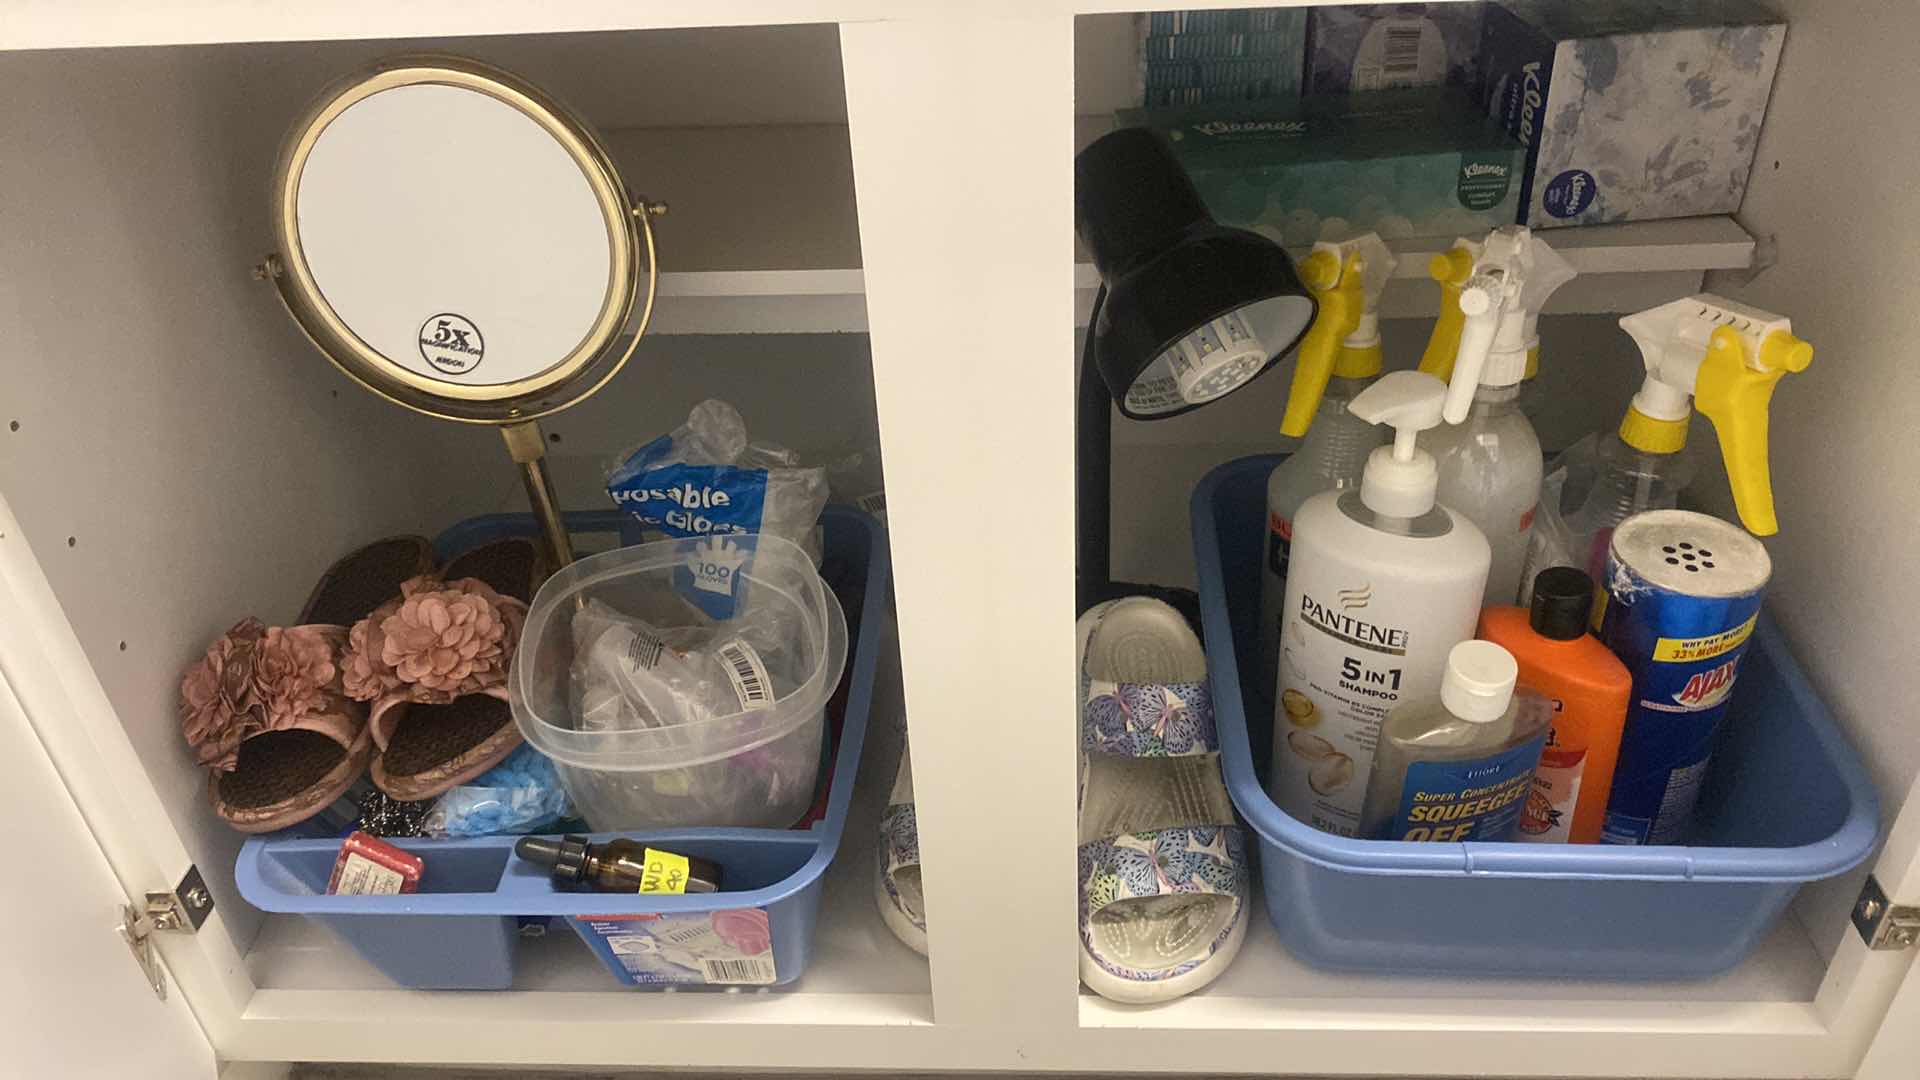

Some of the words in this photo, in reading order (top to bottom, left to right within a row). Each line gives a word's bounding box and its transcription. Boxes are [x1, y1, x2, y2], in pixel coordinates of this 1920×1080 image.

[1192, 121, 1306, 136] Kleenex
[1464, 162, 1508, 178] Kleenex
[694, 562, 730, 578] 100
[1301, 594, 1404, 648] PANTENE
[1340, 656, 1361, 681] 5
[1365, 670, 1385, 685] IN
[1389, 668, 1403, 691] 1
[1679, 660, 1735, 705] AJAX
[1339, 680, 1398, 701] SHAMPOO
[1407, 782, 1527, 824] SQUEEGEE
[643, 861, 663, 892] WD
[666, 868, 683, 891] 40
